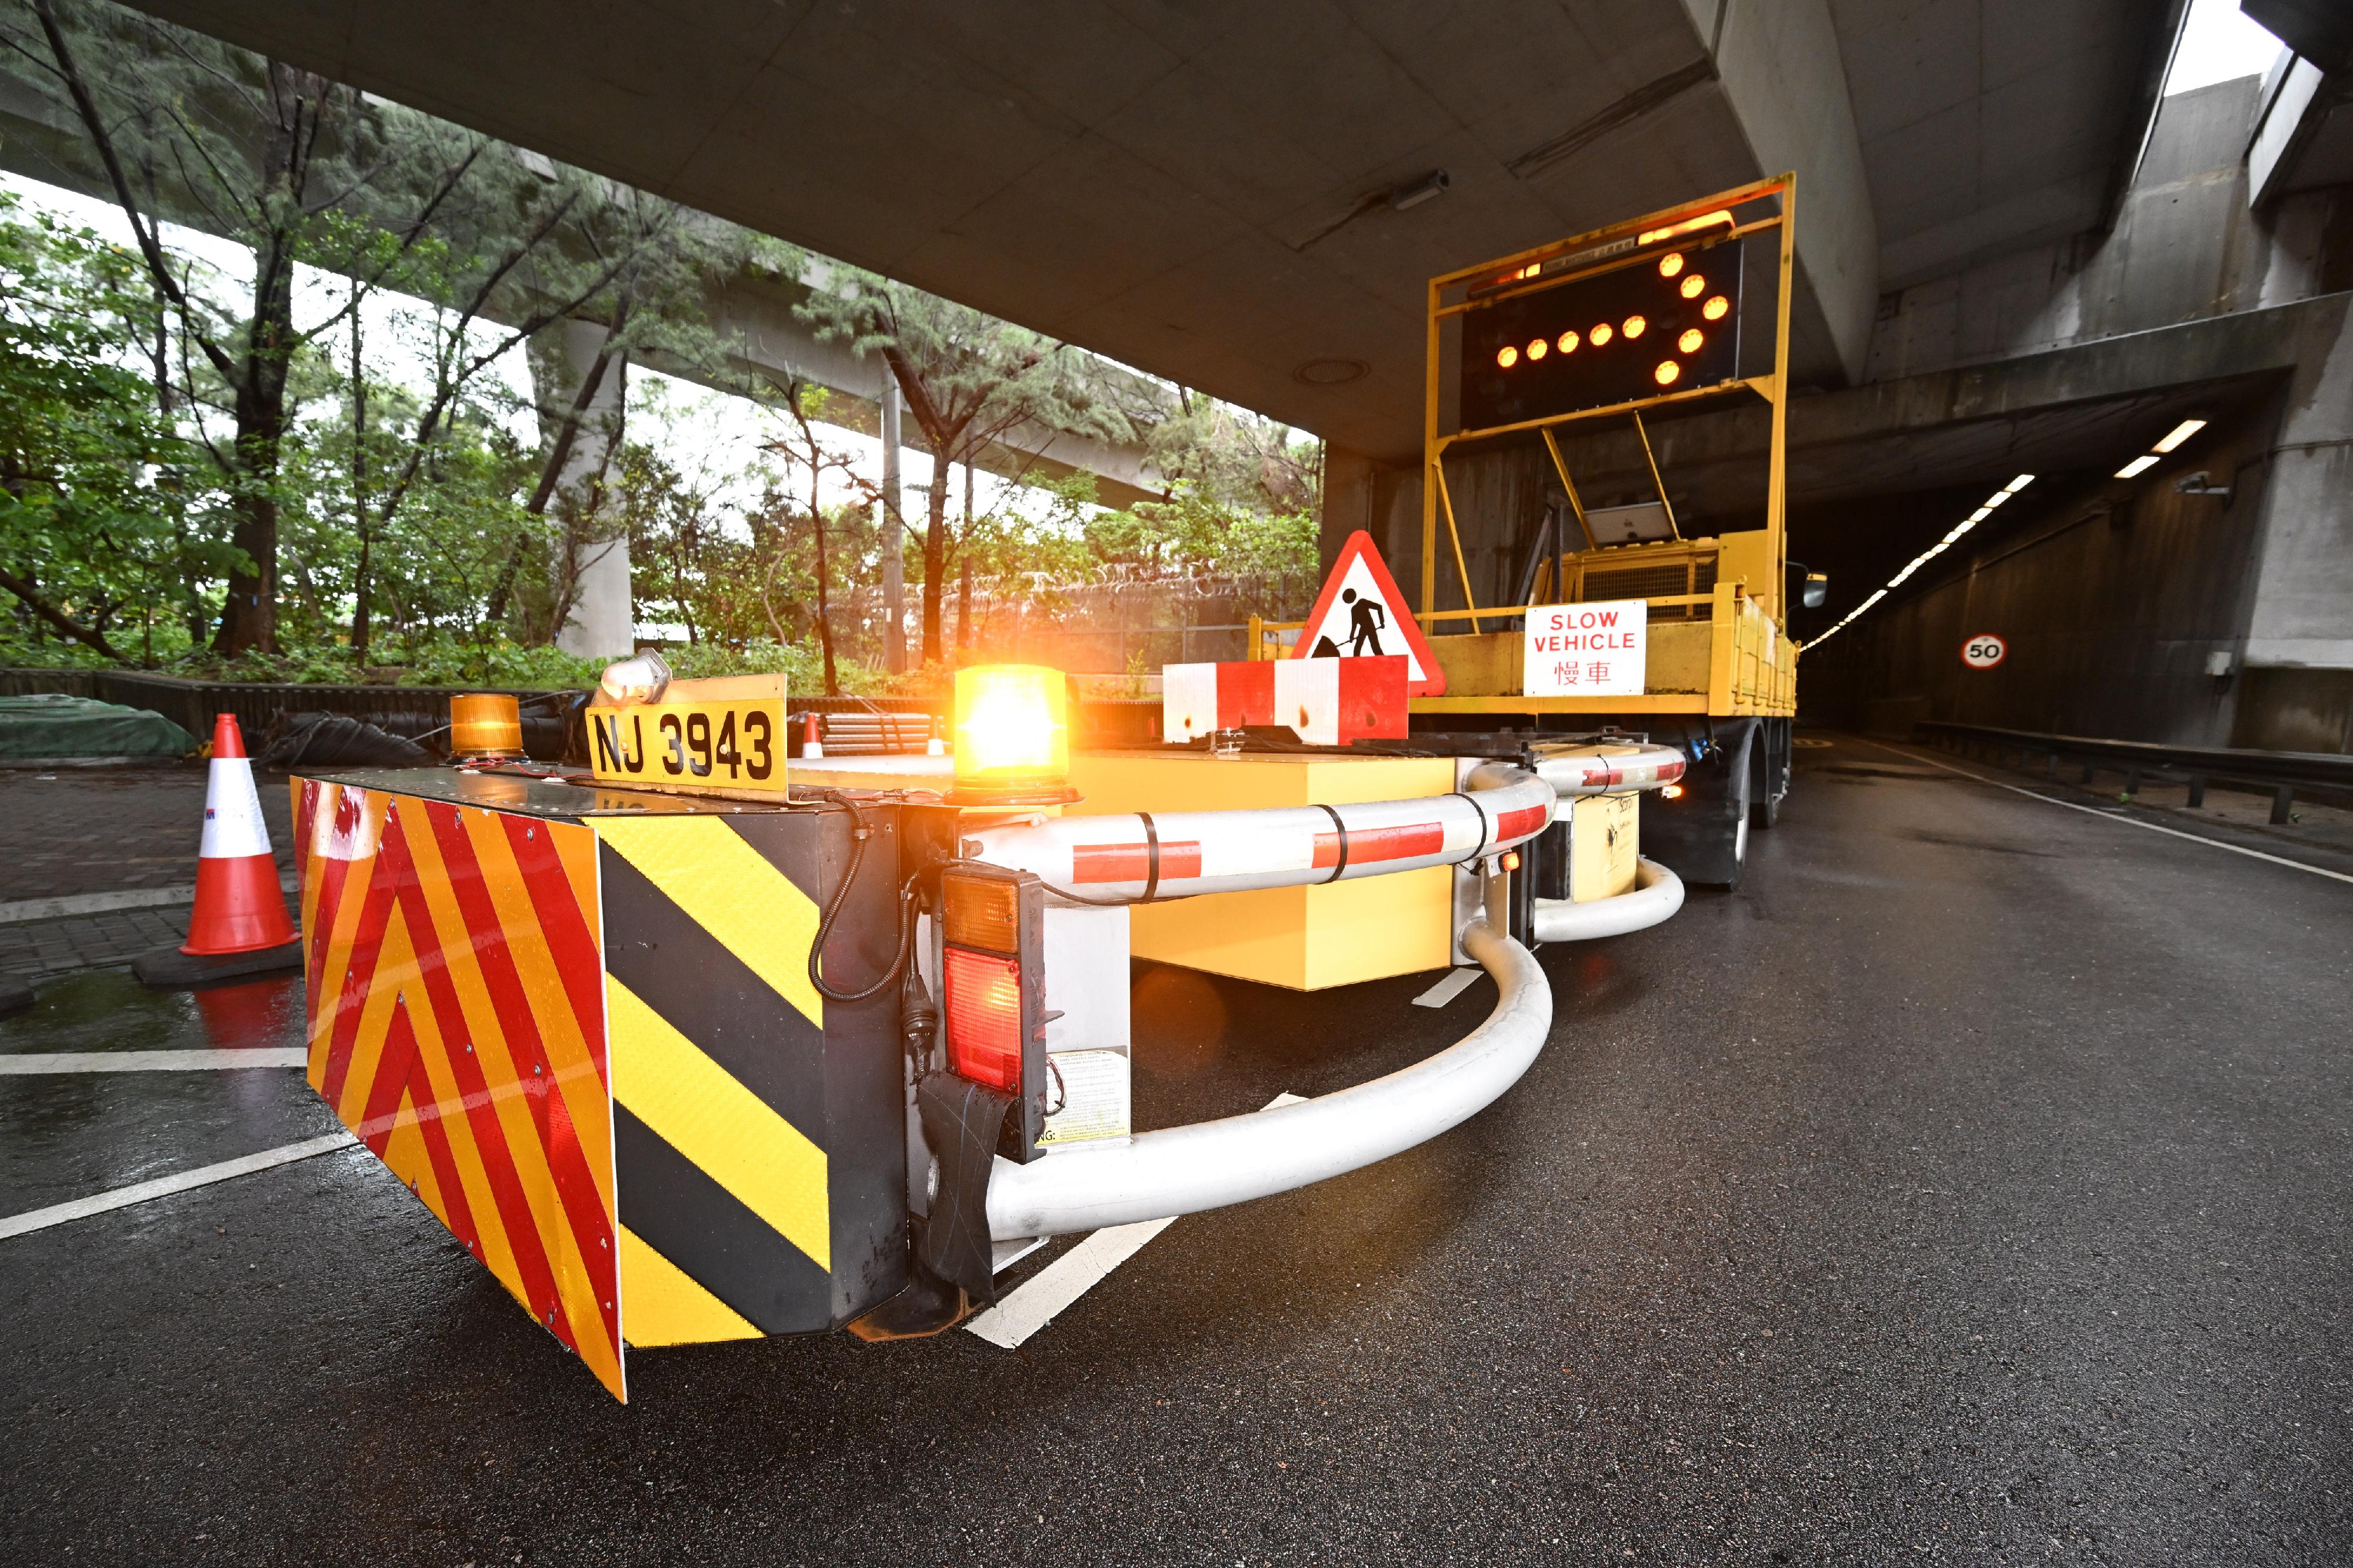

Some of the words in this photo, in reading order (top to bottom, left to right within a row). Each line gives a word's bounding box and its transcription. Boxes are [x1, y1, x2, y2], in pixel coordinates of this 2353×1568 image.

[1550, 612, 1618, 630] SLOW
[1535, 633, 1635, 652] VEHICLE
[1970, 645, 1999, 658] 50
[1554, 661, 1611, 685] 慢車
[595, 715, 644, 773] NJ
[659, 710, 772, 780] 3943
